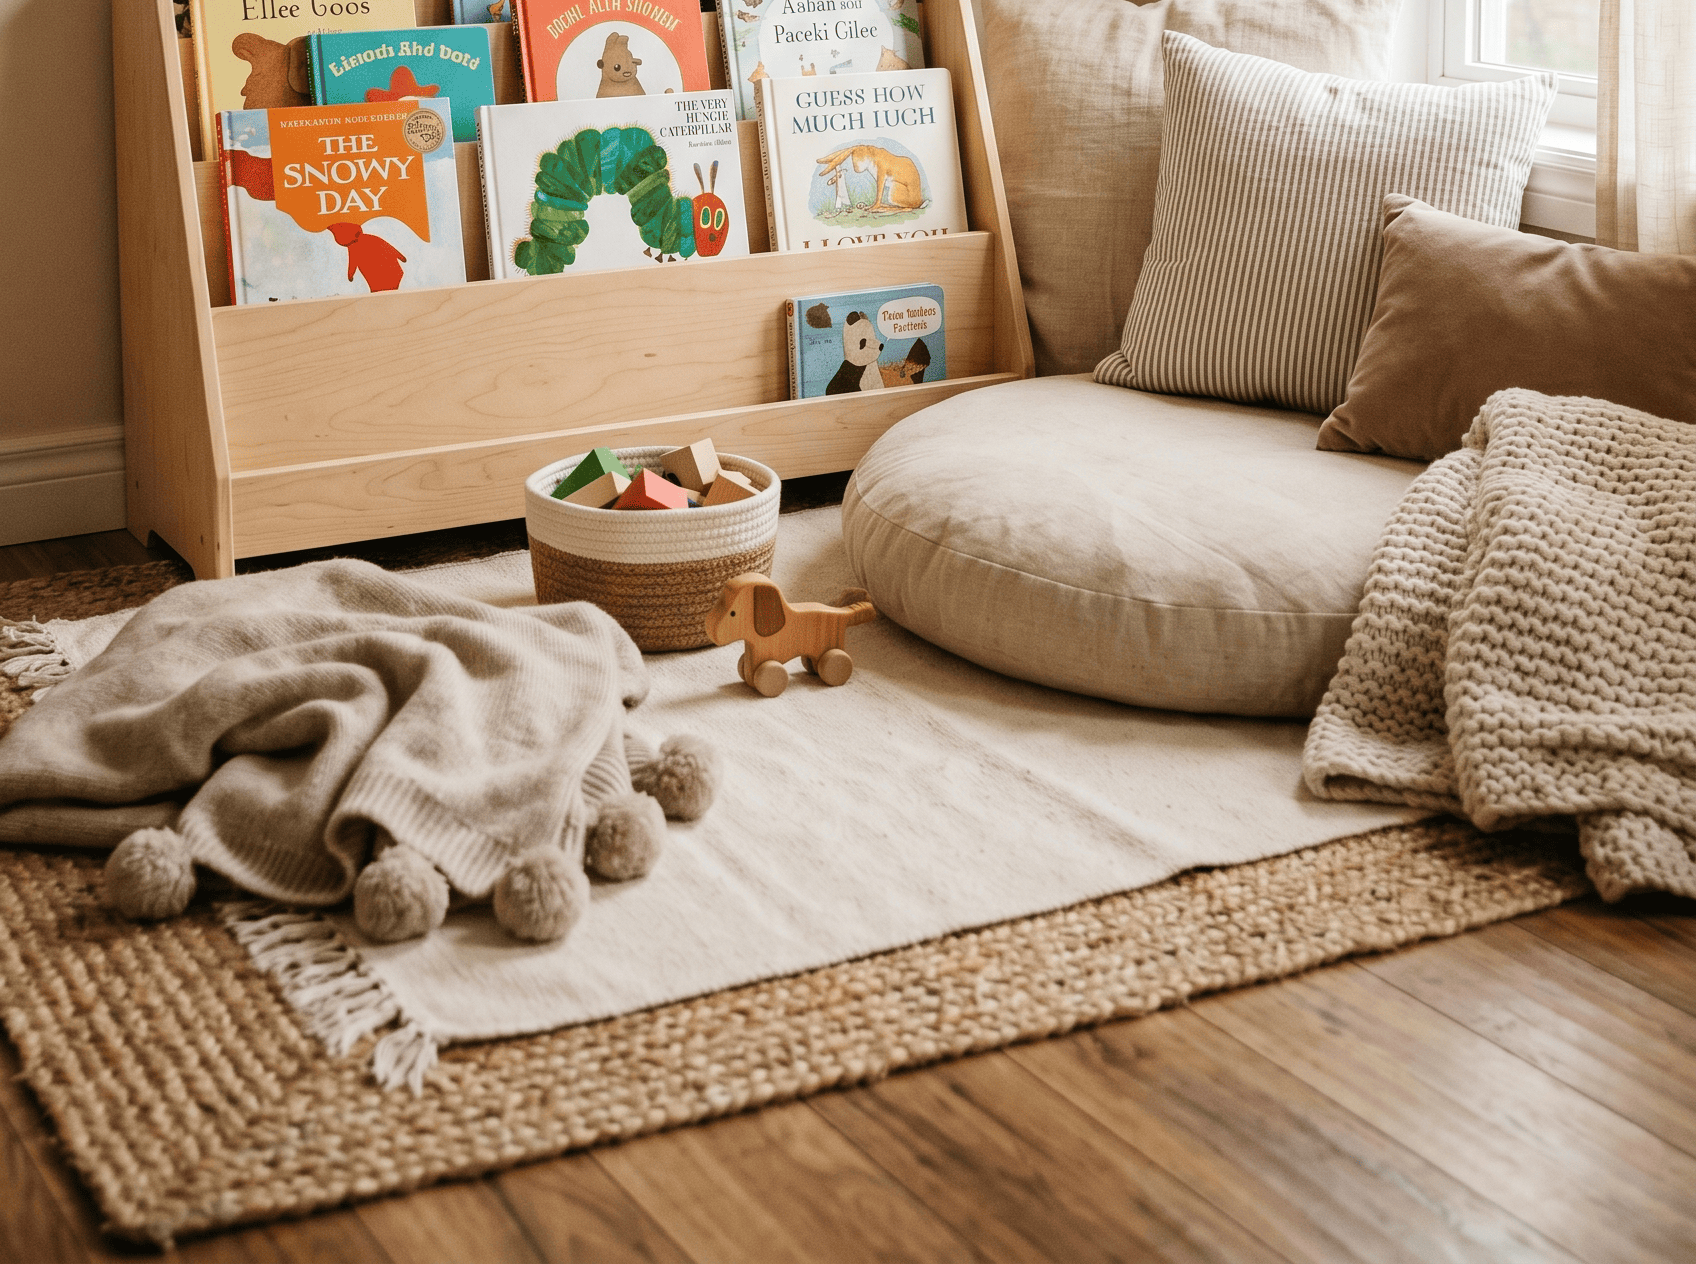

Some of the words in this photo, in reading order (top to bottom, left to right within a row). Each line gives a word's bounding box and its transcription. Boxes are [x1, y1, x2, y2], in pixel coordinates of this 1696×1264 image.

[773, 22, 829, 44] Paceki
[674, 100, 699, 112] THE
[700, 98, 728, 110] VERY
[796, 88, 865, 109] GUESS
[872, 84, 925, 103] HOW
[659, 122, 733, 138] CATERPILLAR
[792, 111, 865, 135] MUCH
[317, 134, 379, 156] THE
[283, 155, 415, 188] SNOWY
[316, 186, 389, 215] DAY
